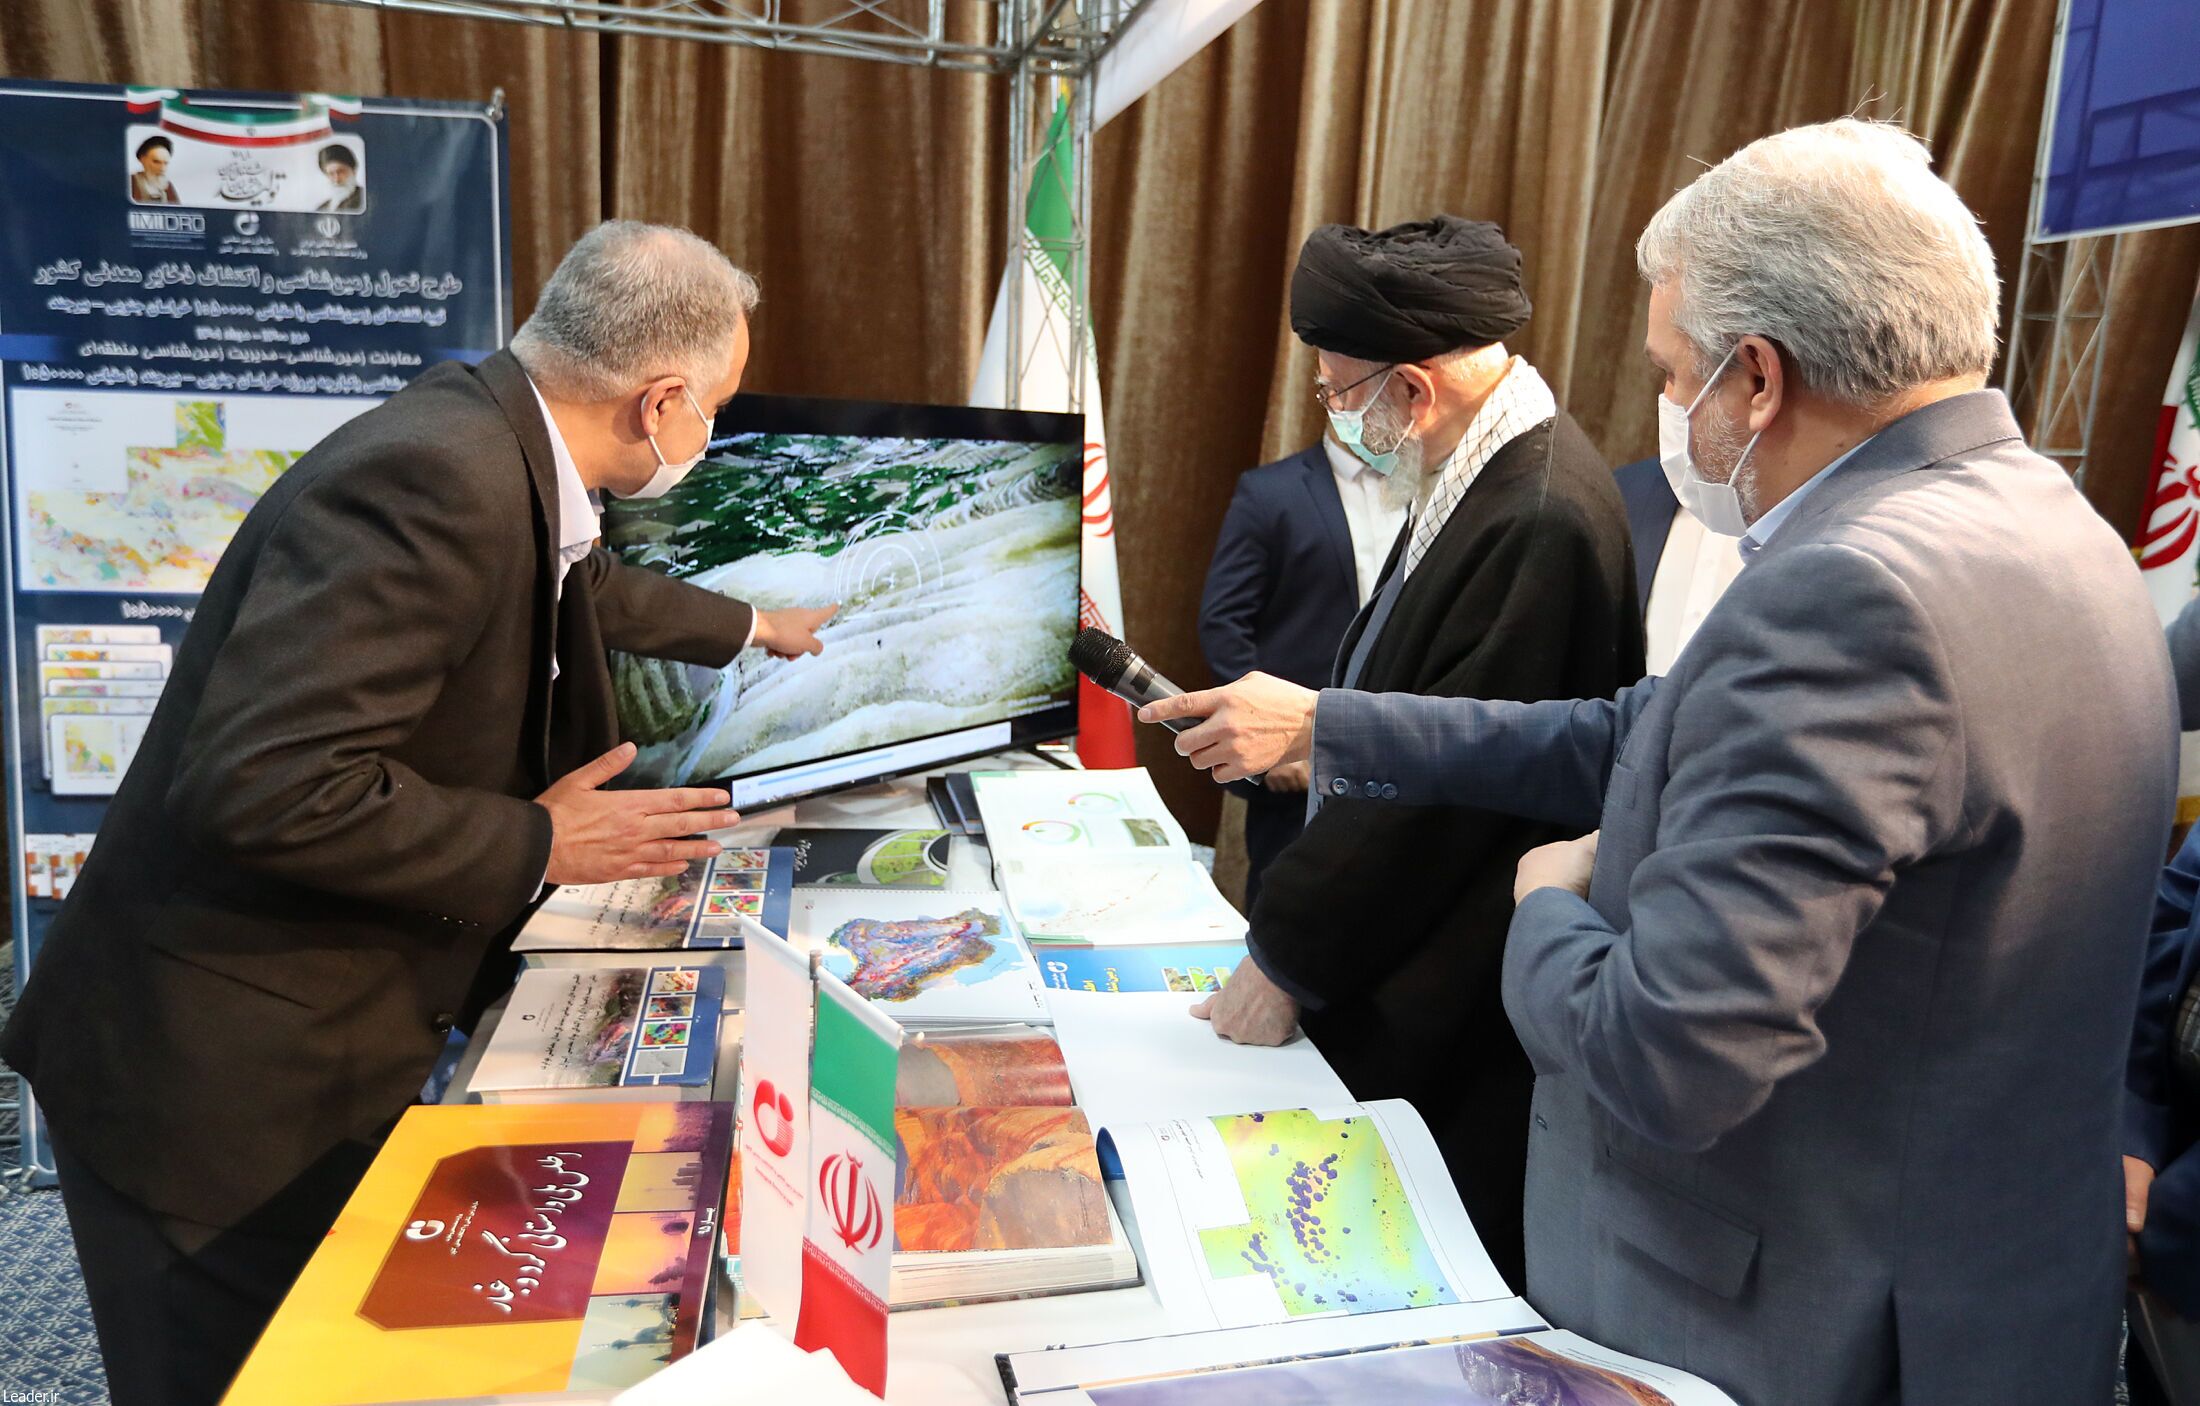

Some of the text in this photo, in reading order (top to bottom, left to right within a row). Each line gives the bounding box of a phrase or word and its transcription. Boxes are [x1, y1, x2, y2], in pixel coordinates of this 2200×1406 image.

[130, 211, 205, 233] IMIDRO
[34, 257, 82, 286] کشور
[83, 258, 143, 288] معدنی
[144, 262, 196, 289] ذخایر
[197, 262, 260, 288] اکتشاف
[260, 273, 274, 294] و
[374, 269, 420, 298] تحول
[421, 272, 462, 300] طرح
[368, 350, 422, 367] معاونت
[473, 1152, 589, 1313] اطلس ملی و استانی گرد و غبار
